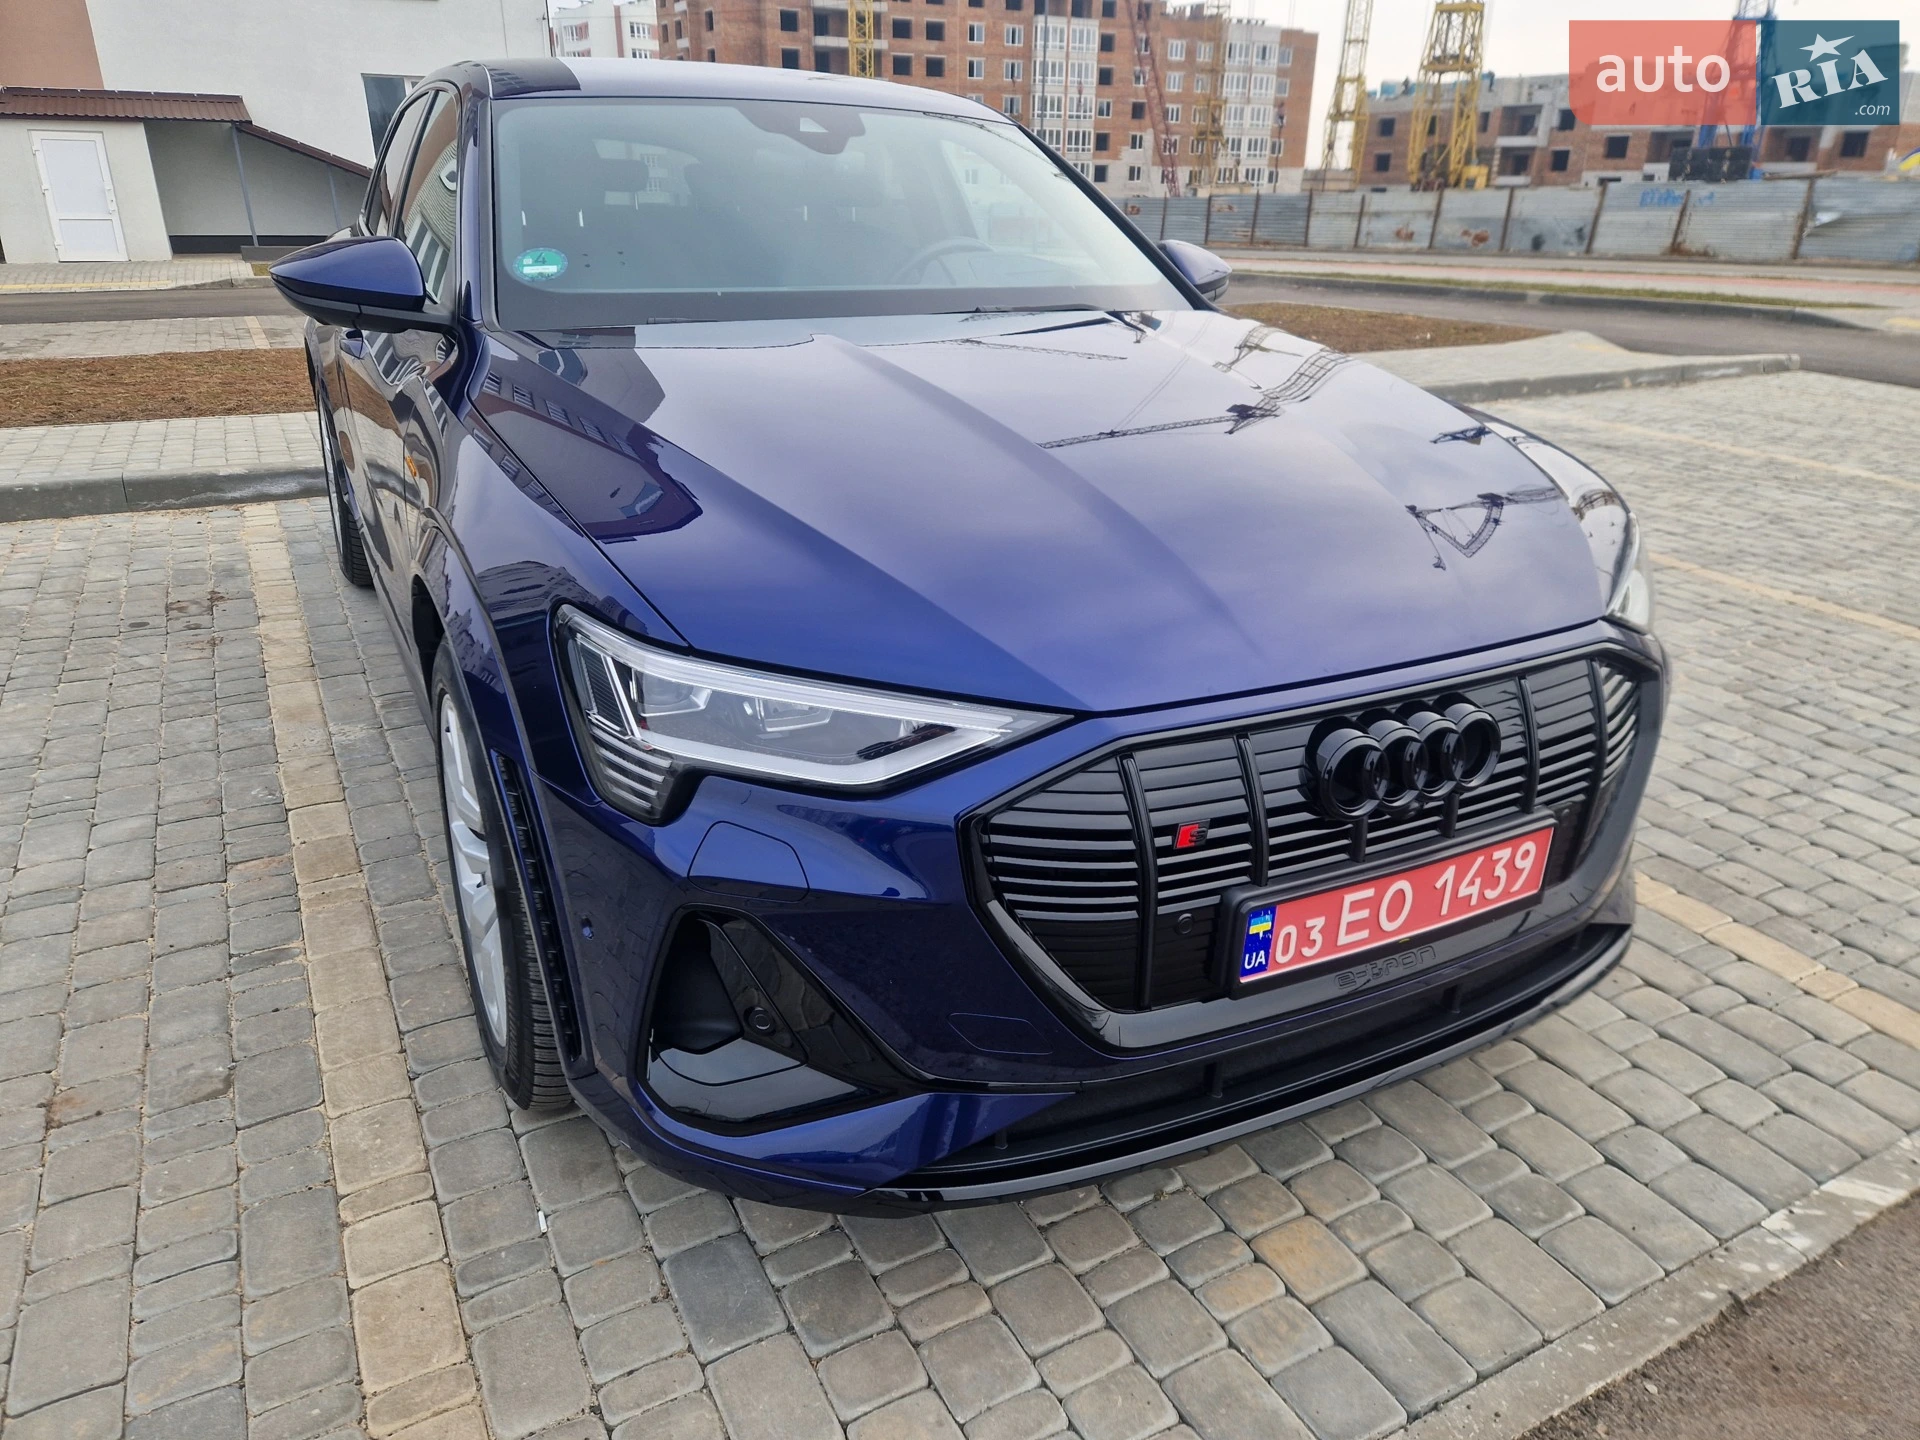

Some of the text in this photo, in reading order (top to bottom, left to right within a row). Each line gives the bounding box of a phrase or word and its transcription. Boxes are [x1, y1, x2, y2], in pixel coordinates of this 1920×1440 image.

[1275, 841, 1537, 963] 03 EO 1439
[1244, 949, 1267, 970] UA
